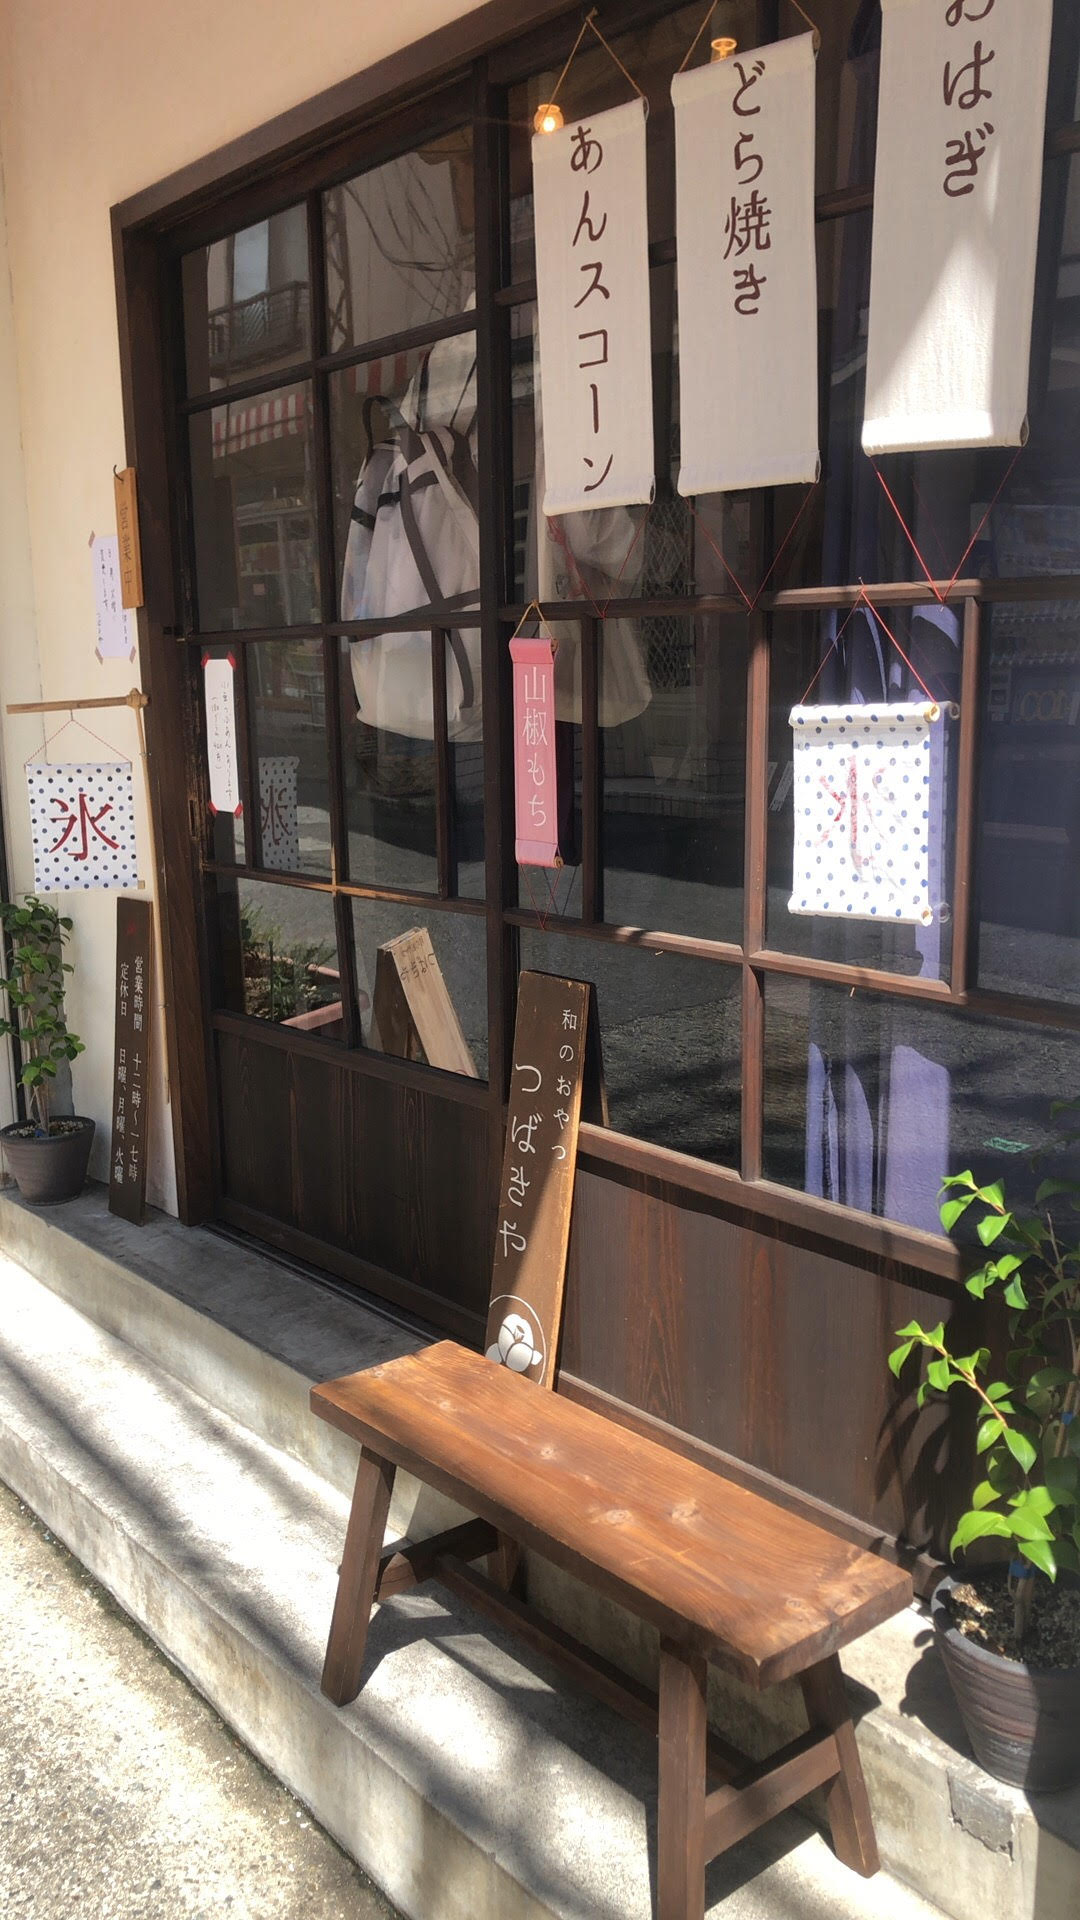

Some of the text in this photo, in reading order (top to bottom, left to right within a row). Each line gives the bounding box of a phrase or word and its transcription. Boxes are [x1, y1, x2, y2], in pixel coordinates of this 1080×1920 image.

[723, 60, 772, 315] どら焼き
[570, 125, 614, 493] あんスコーン
[522, 666, 548, 827] 山椒もち
[49, 793, 120, 861] 氷
[120, 961, 129, 1017] 定休日
[133, 956, 144, 1032] 営業時間
[500, 1063, 543, 1258] つばきや
[551, 1009, 578, 1160] 和のおやつ
